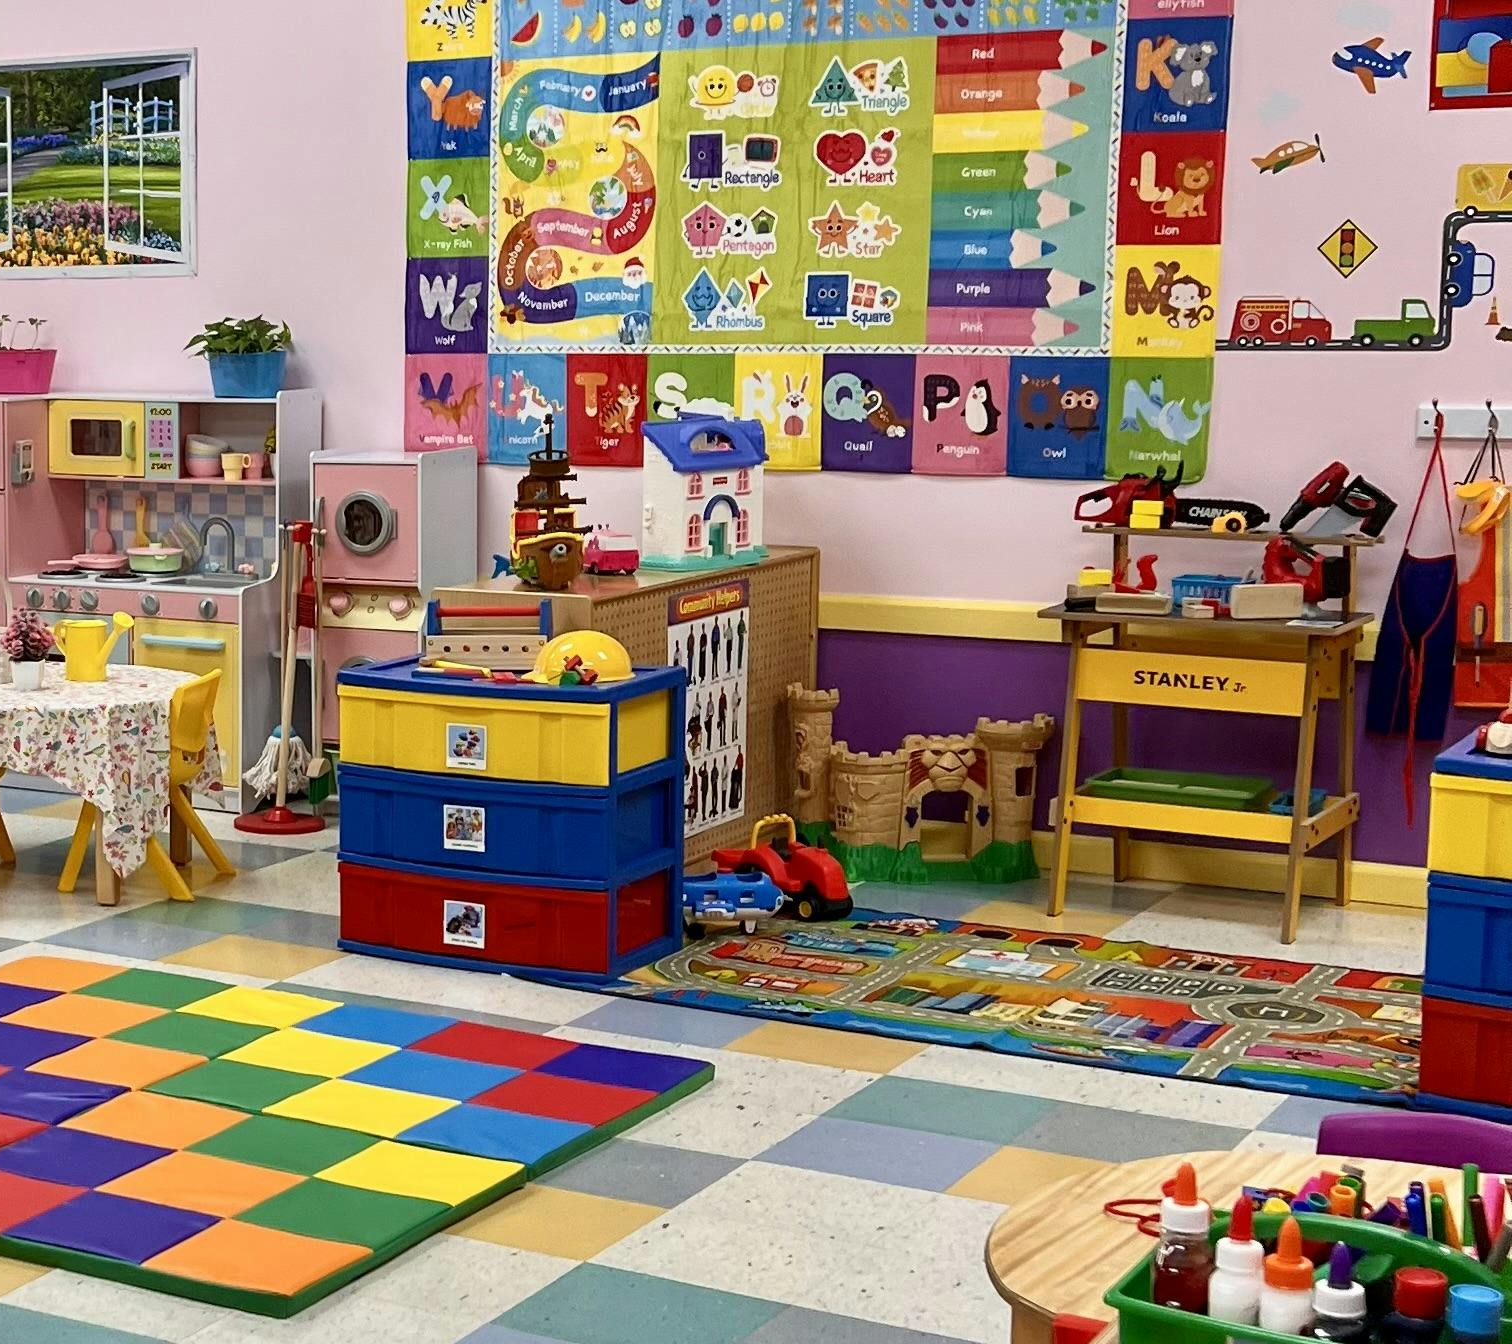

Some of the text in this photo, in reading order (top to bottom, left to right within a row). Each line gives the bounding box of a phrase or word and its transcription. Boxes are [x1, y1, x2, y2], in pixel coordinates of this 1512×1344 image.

[972, 48, 995, 60] Red
[1136, 36, 1178, 90] K
[539, 80, 582, 96] February
[608, 79, 647, 96] January
[961, 89, 1003, 101] Orange
[420, 75, 453, 121] Y
[862, 94, 907, 113] Triangle
[509, 96, 523, 131] March
[1153, 112, 1187, 123] Koala
[514, 146, 537, 168] April
[725, 171, 780, 188] Rectangle
[859, 169, 895, 183] Heart
[961, 167, 996, 178] Green
[1140, 151, 1173, 202] L
[420, 175, 452, 220] X
[613, 202, 642, 239] August
[964, 207, 992, 218] Cyan
[537, 220, 589, 237] September
[1155, 225, 1179, 236] Lion
[453, 240, 473, 249] Fish
[722, 240, 775, 255] Pentagon
[856, 242, 881, 254] Star
[964, 245, 987, 255] Blue
[504, 239, 525, 286] October
[420, 273, 457, 319] W
[585, 291, 641, 302] December
[956, 283, 991, 295] Purple
[1125, 262, 1172, 316] M
[517, 291, 568, 311] November
[716, 316, 763, 328] Rhombus
[852, 310, 891, 324] Square
[960, 322, 983, 333] Pink
[435, 336, 456, 345] Wolf
[575, 372, 608, 417] T
[653, 372, 687, 420] S
[742, 370, 775, 422] R
[823, 372, 867, 423] Q
[922, 374, 961, 422] P
[844, 440, 873, 452] Quail
[936, 443, 980, 456] Penguin
[1042, 447, 1067, 459] Owl
[679, 588, 740, 614] Community Helpers
[1133, 670, 1230, 691] STANLEY
